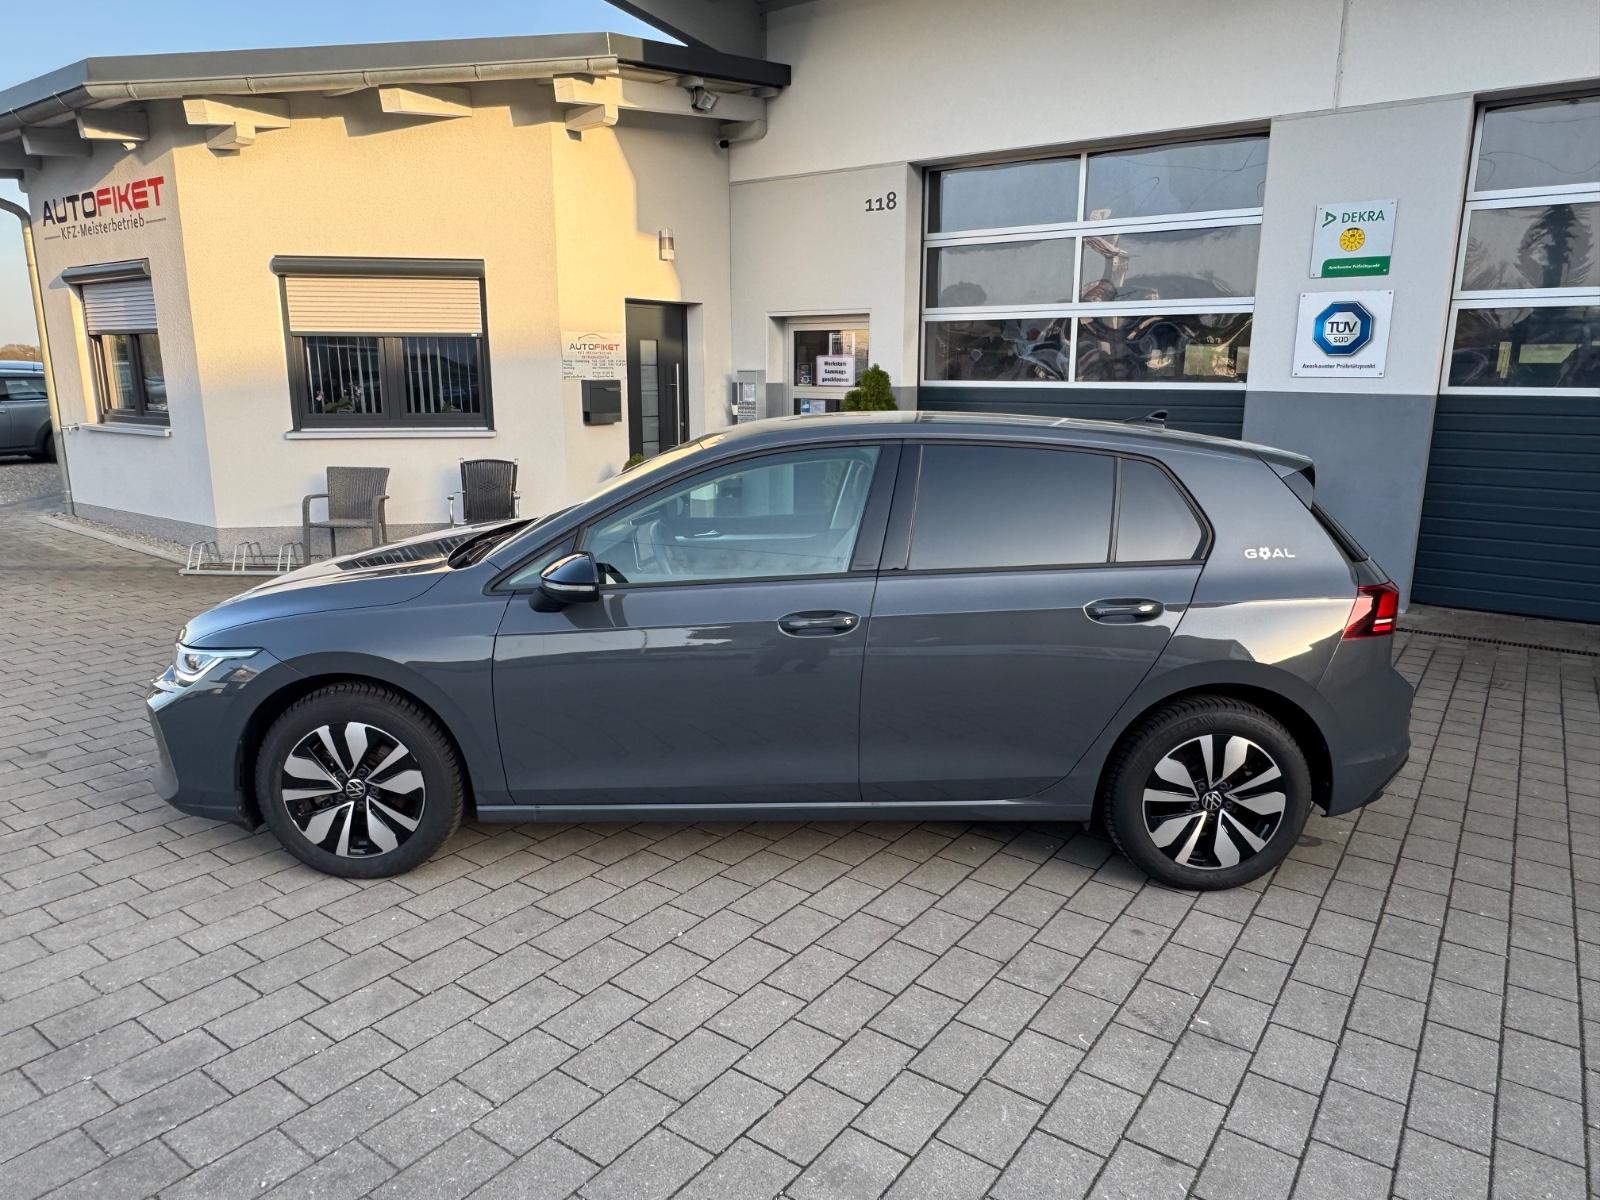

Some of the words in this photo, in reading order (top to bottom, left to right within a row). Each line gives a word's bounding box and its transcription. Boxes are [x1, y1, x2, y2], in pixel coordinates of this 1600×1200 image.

[43, 176, 164, 227] AUTOFIKET
[865, 191, 897, 212] 118
[1341, 210, 1385, 223] DEKRA
[60, 212, 145, 240] KFZ-Meisterbetrieb
[1328, 321, 1358, 333] TÜV
[569, 343, 620, 351] AUTOFIKET
[1244, 547, 1296, 560] GOAL
